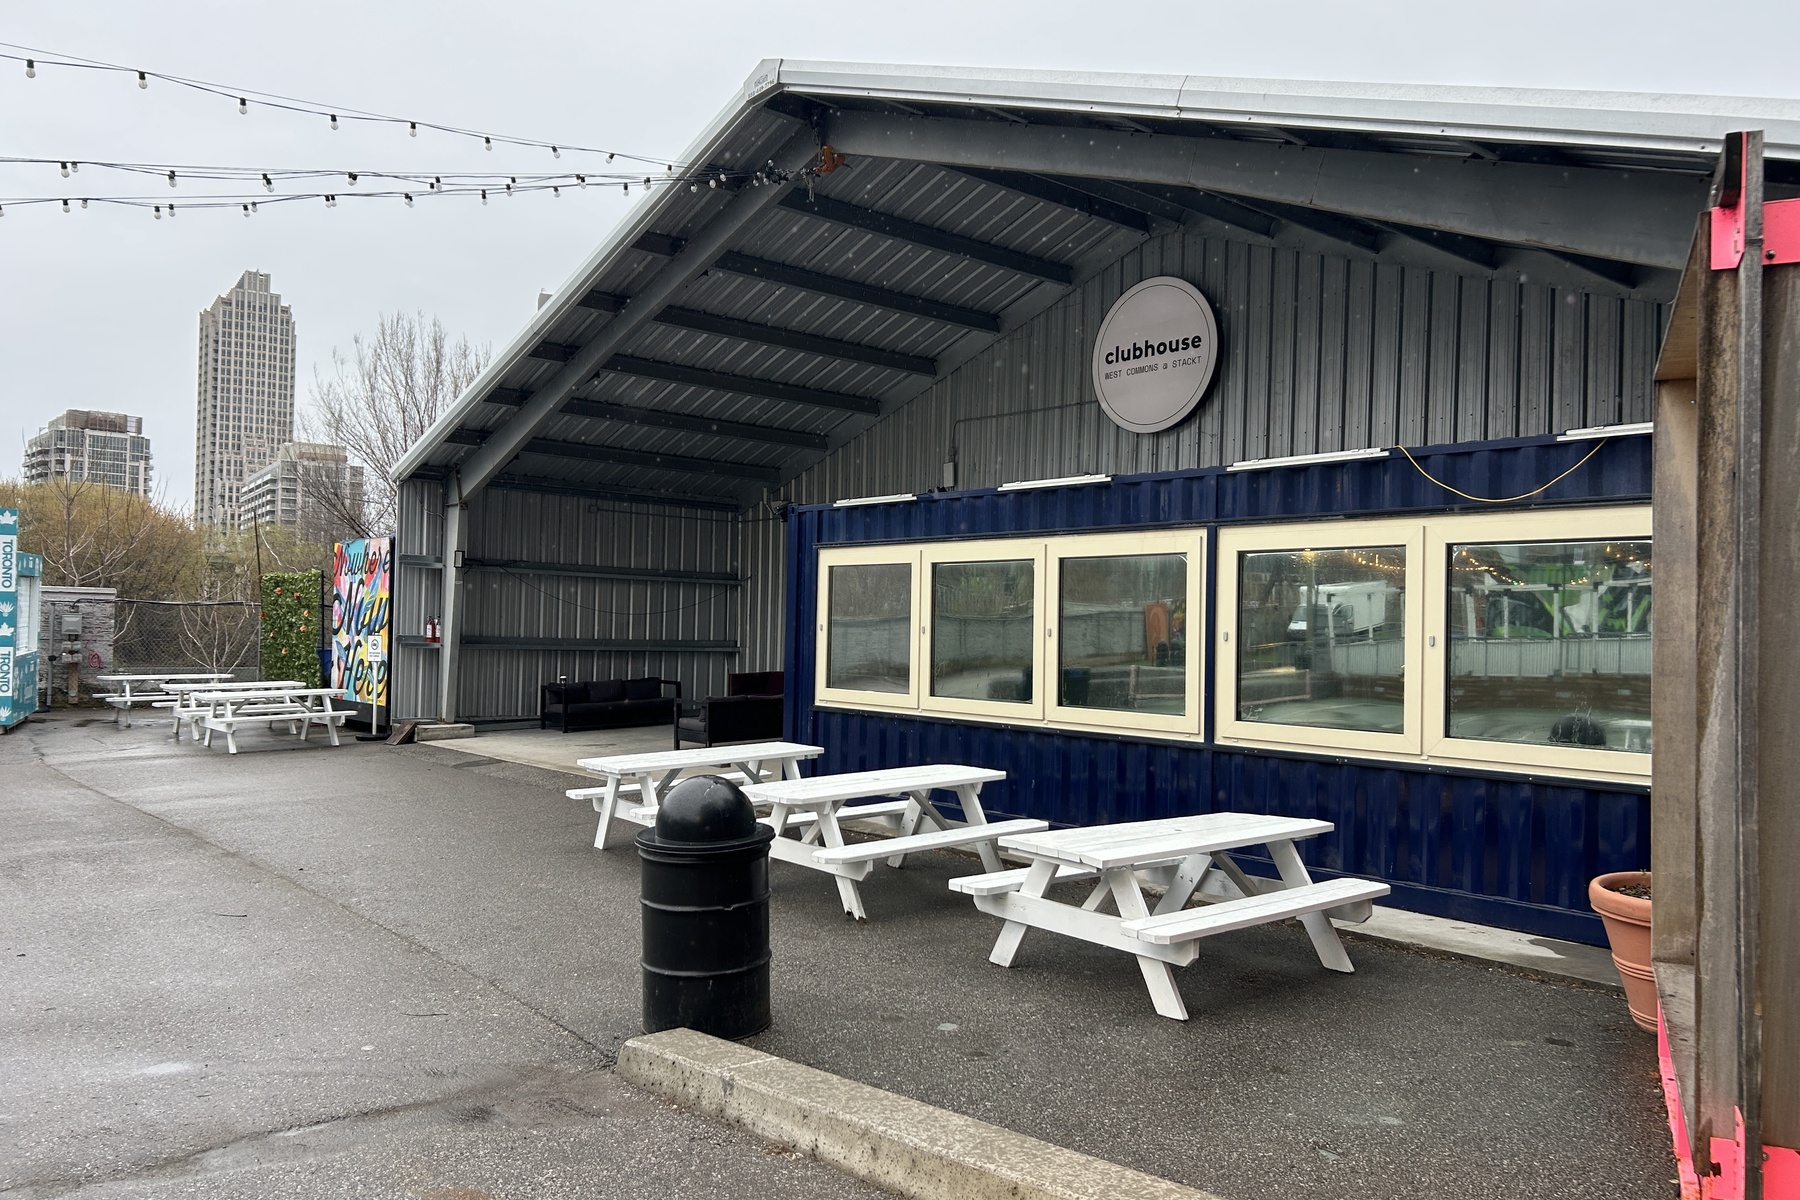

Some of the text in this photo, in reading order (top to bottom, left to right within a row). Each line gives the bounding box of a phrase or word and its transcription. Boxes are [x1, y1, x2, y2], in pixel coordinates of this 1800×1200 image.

[1104, 369, 1122, 380] WEST
[1126, 363, 1159, 376] COMMONS
[1172, 355, 1202, 368] STACKT
[1105, 335, 1202, 365] clubhouse
[2, 540, 13, 588] TORONTO
[334, 542, 390, 577] Nowhere
[332, 578, 389, 636] Now
